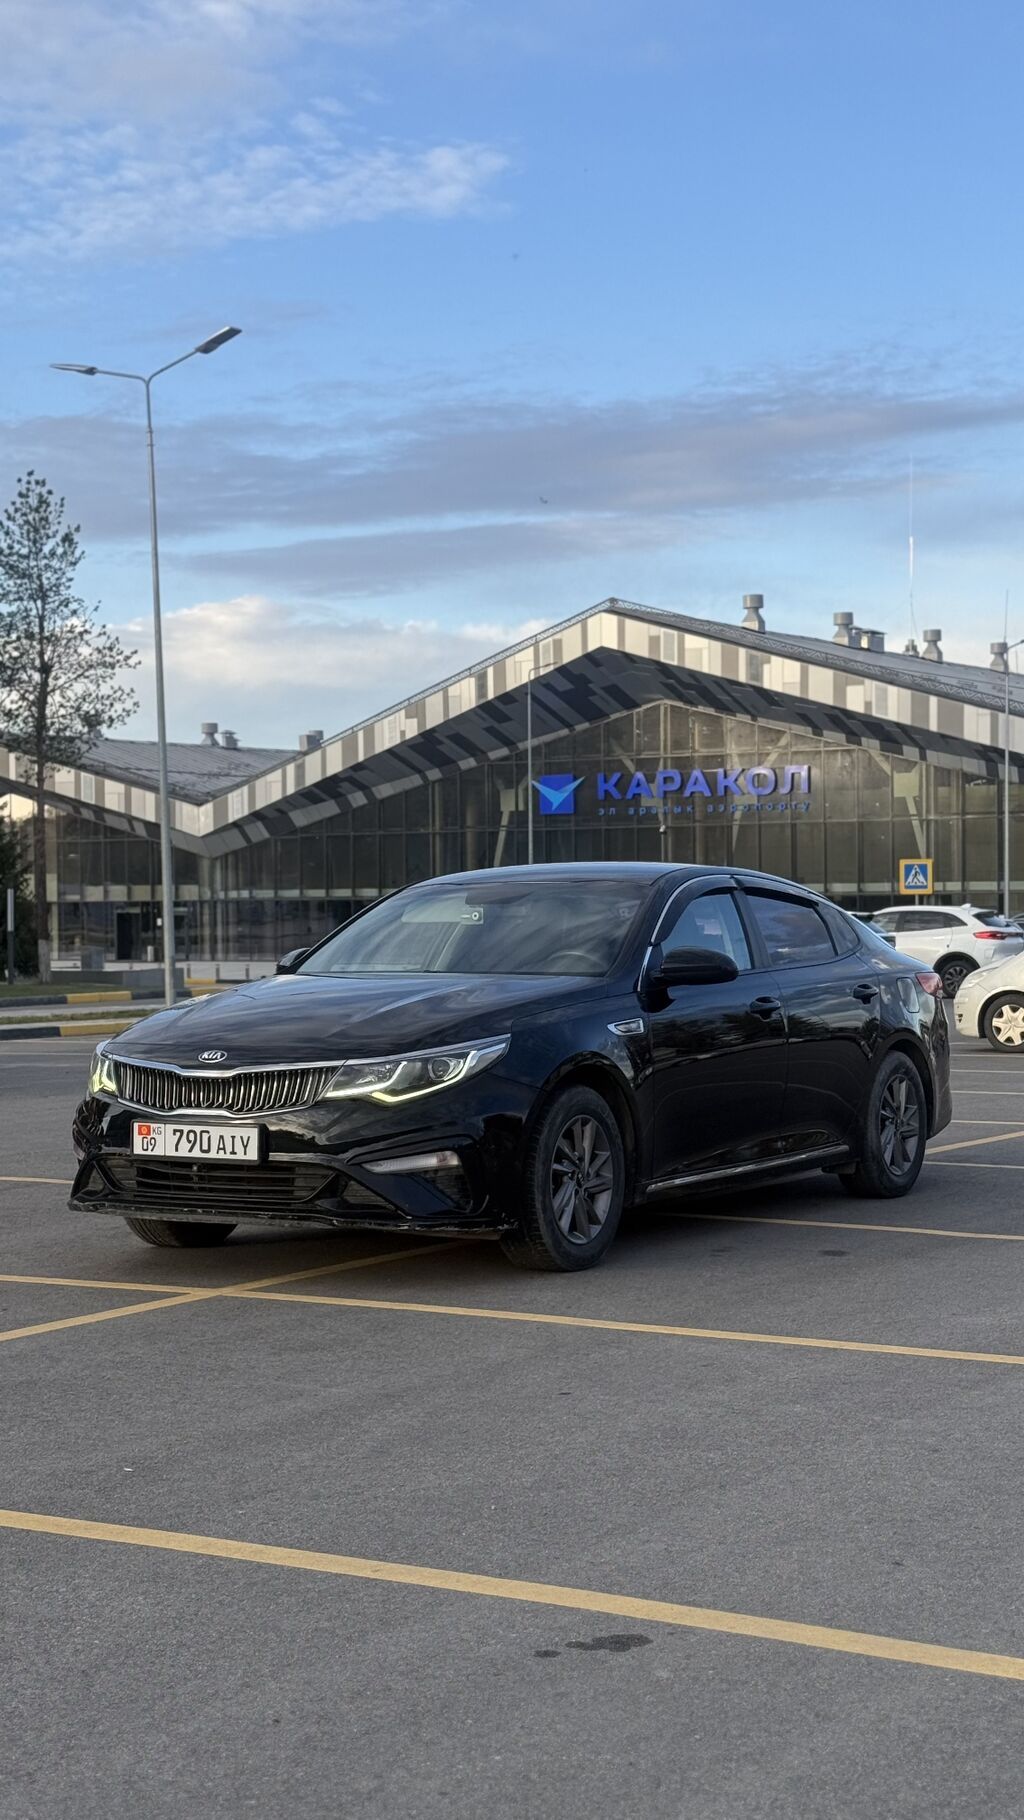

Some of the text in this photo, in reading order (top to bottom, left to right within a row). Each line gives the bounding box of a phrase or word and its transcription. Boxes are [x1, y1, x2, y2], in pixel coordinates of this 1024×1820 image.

[597, 765, 811, 799] КАРАКОЛ
[201, 1051, 222, 1060] KIA
[152, 1126, 162, 1136] KG
[141, 1136, 157, 1152] 09
